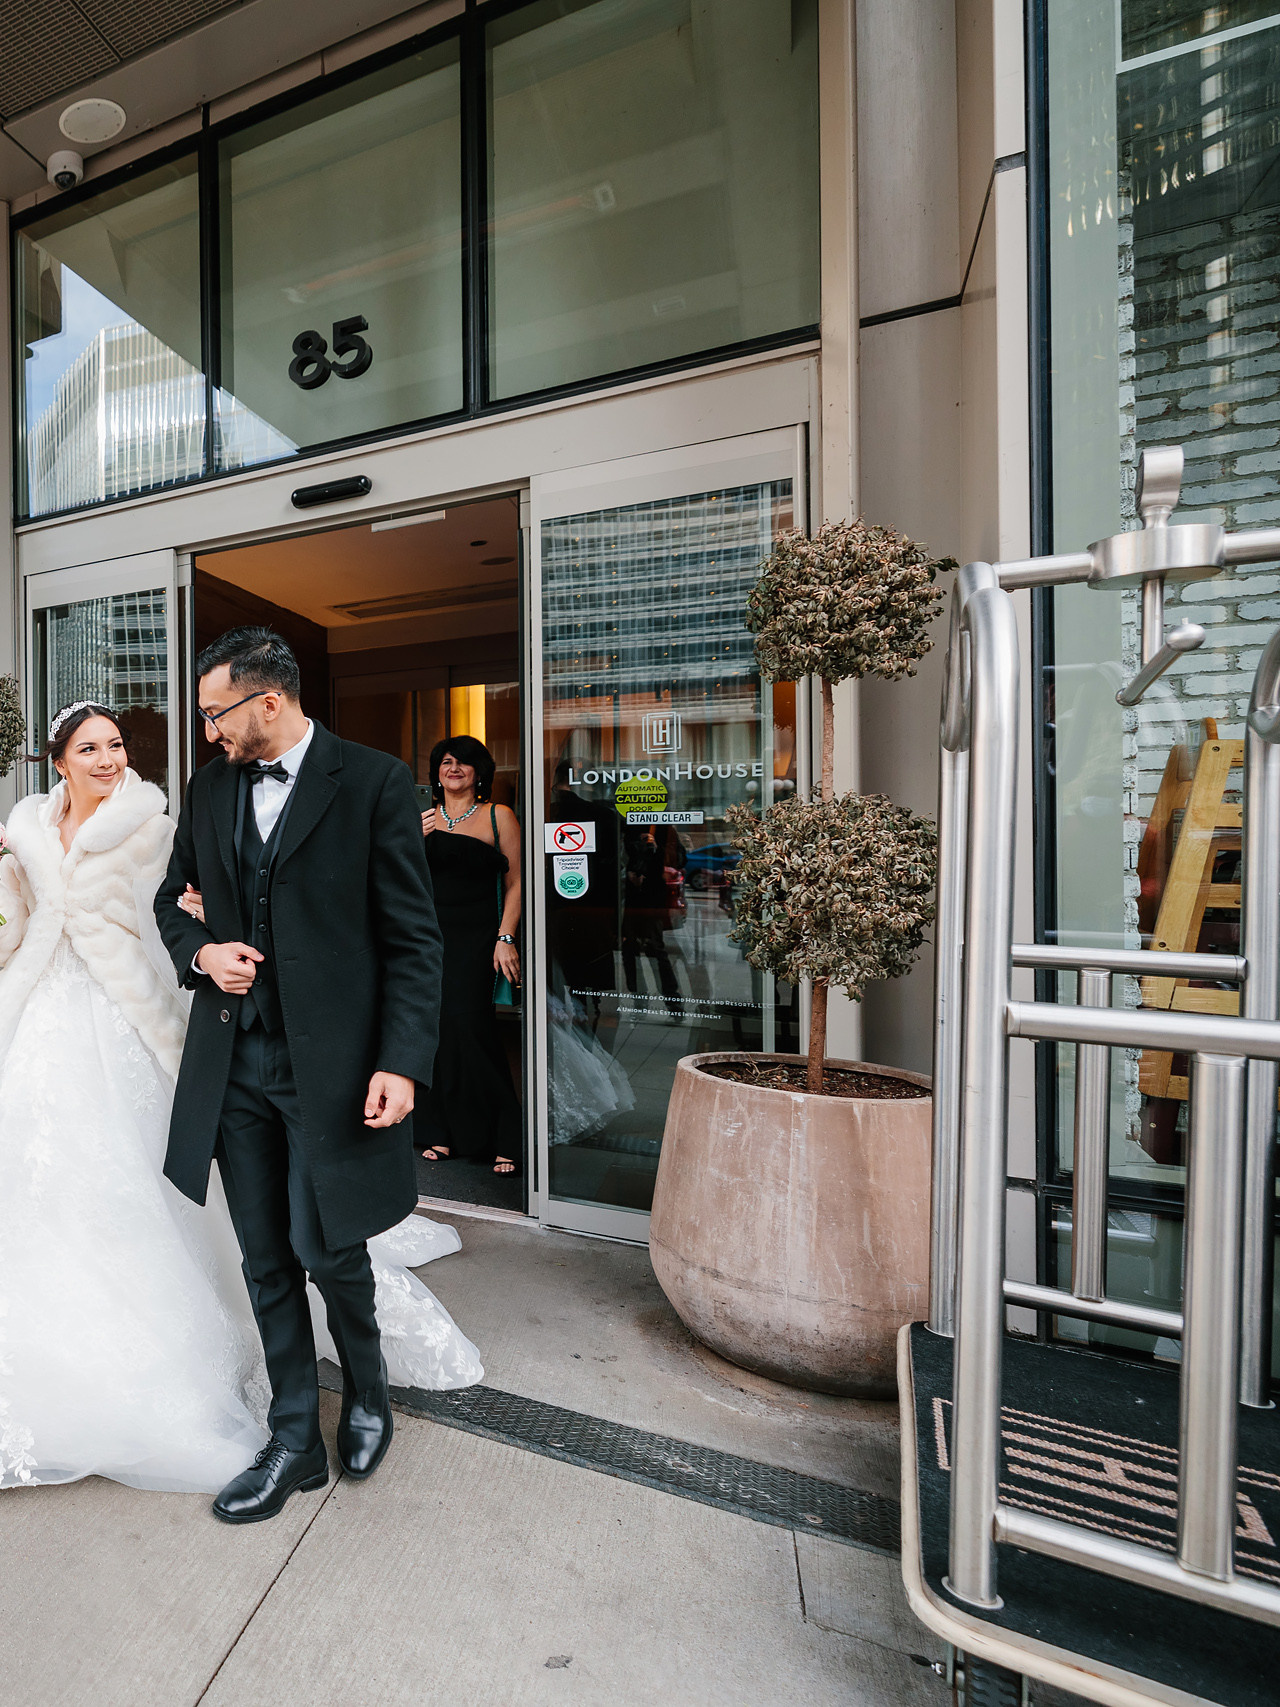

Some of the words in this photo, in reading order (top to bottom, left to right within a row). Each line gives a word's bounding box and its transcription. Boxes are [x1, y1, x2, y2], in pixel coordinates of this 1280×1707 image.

[287, 313, 373, 391] 85
[568, 761, 765, 786] LONDONHOUSE
[617, 785, 664, 793] AUTOMATIC
[616, 794, 666, 804] CAUTION
[629, 813, 659, 823] STAND
[661, 813, 692, 823] CLEAR
